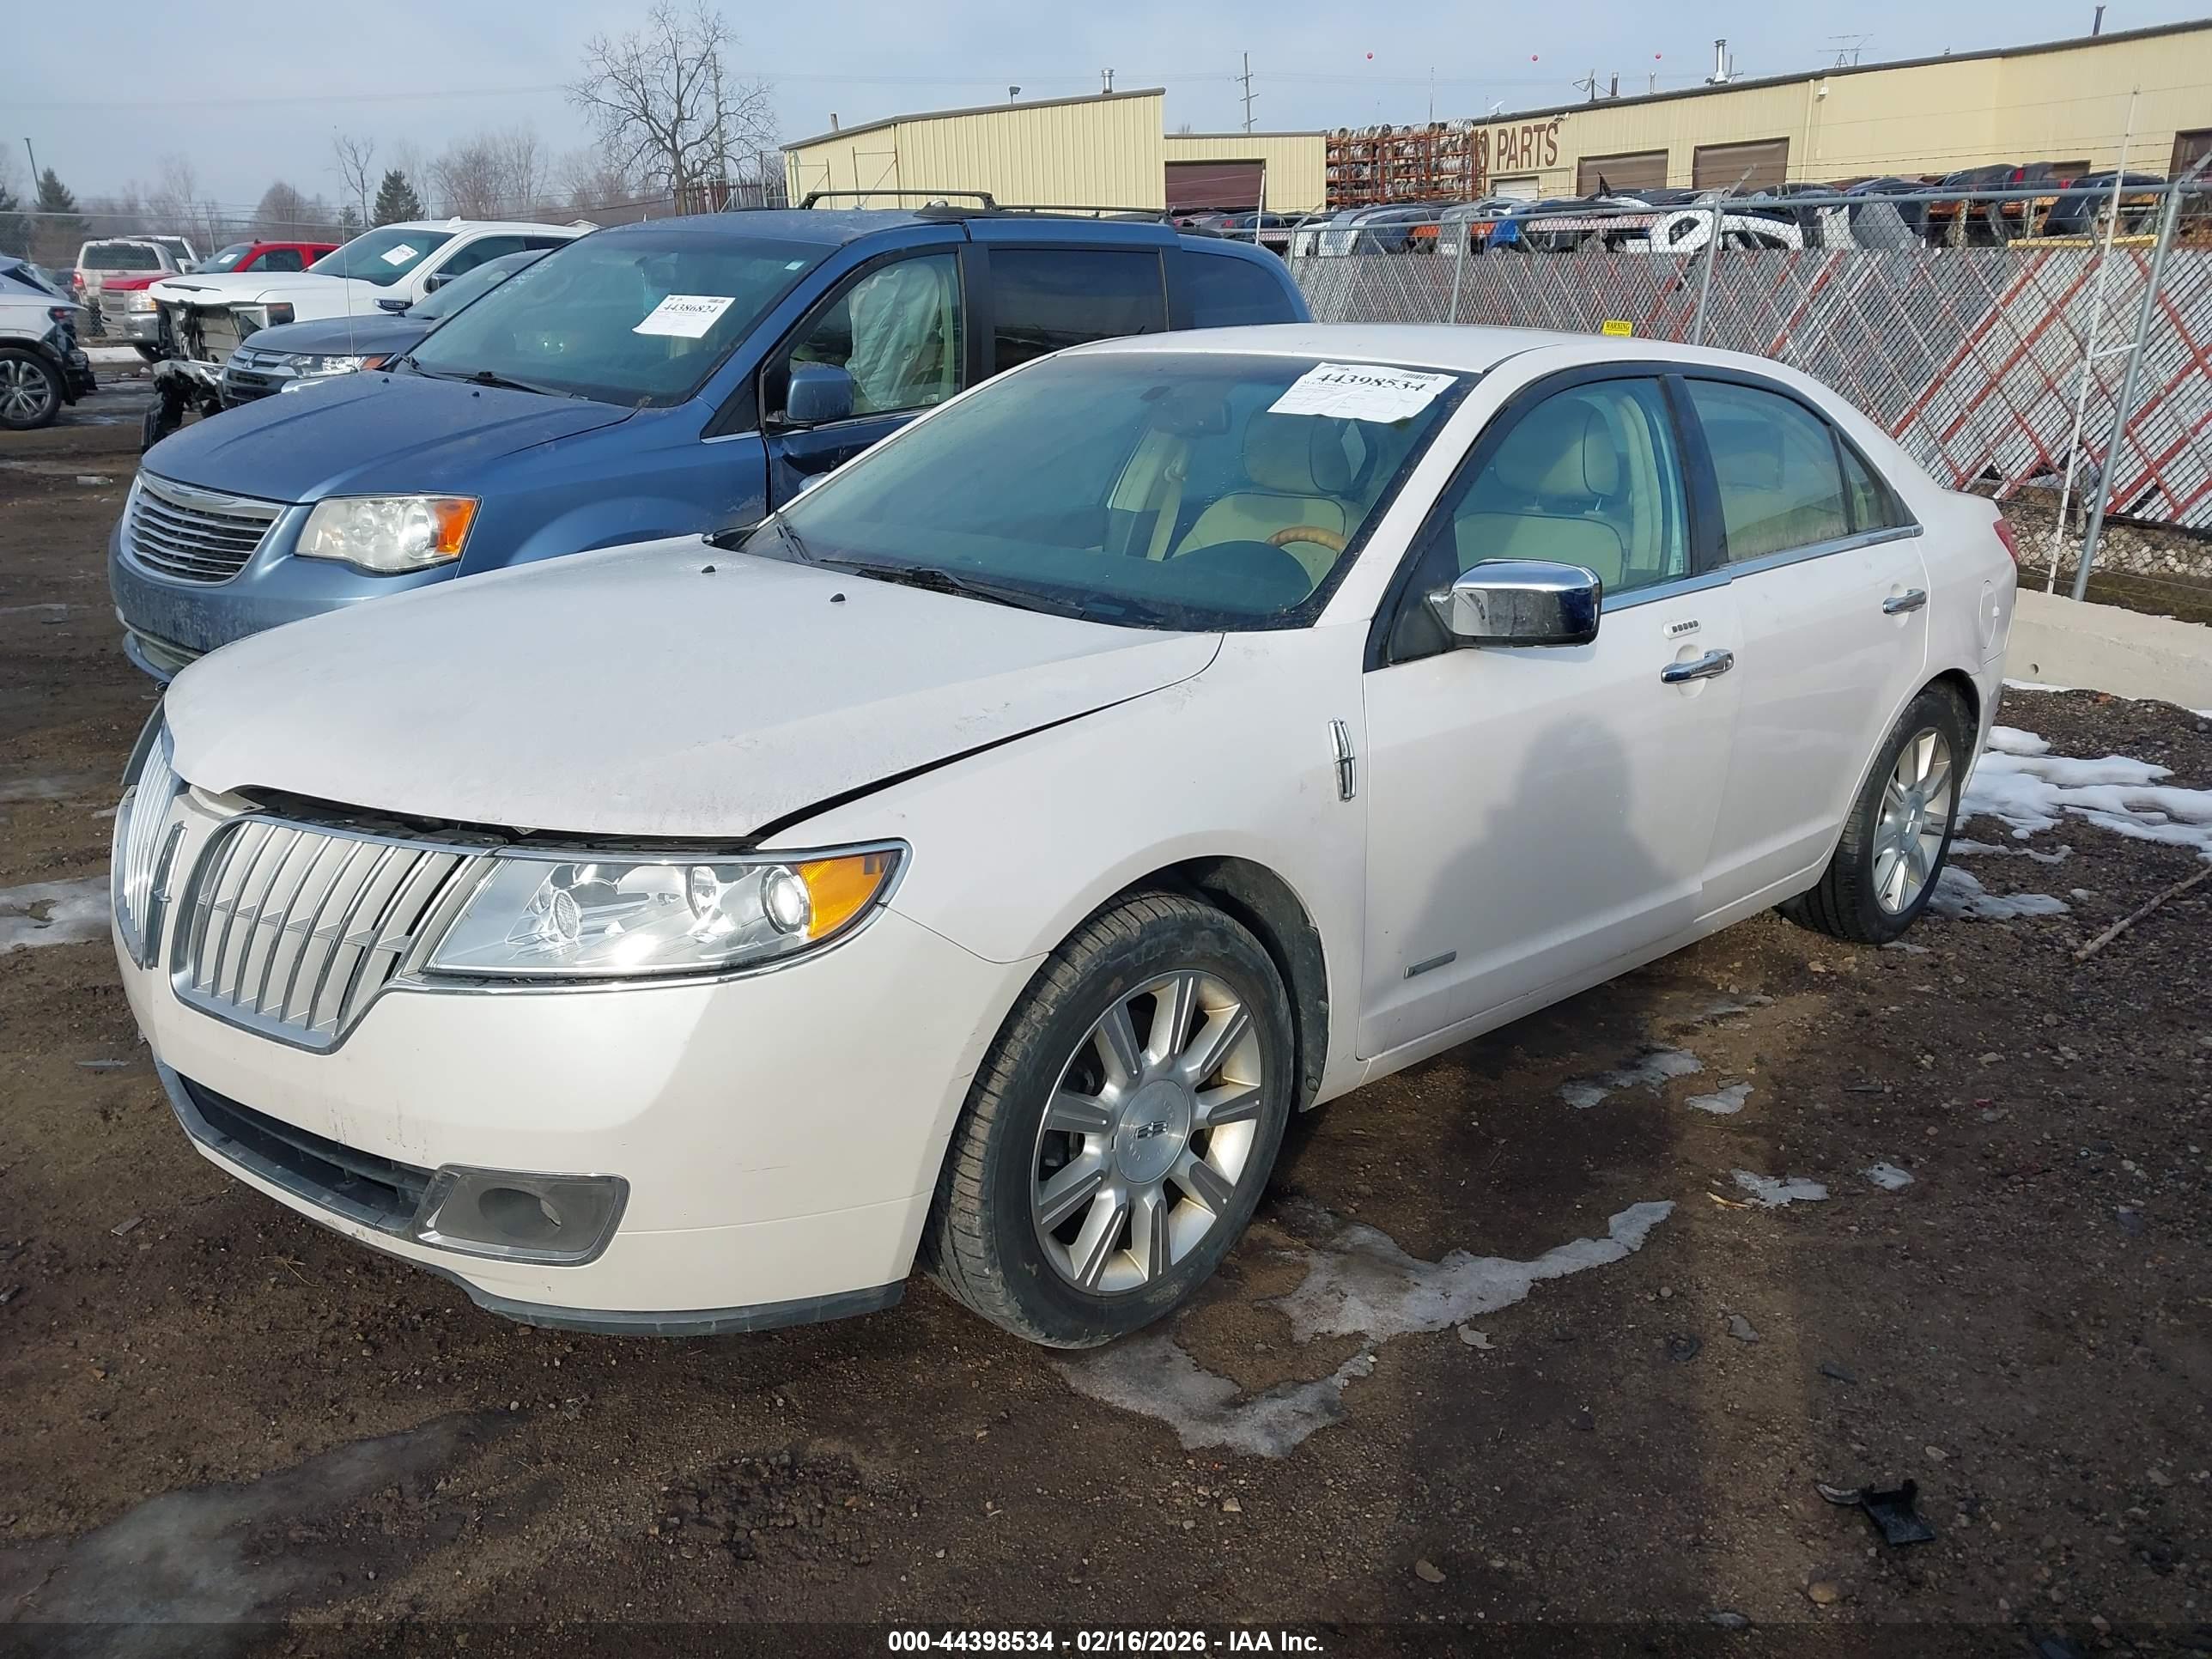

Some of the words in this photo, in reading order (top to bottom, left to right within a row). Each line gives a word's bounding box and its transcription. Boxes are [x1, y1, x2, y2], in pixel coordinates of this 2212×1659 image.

[1497, 122, 1559, 171] PARTS
[664, 303, 719, 314] 44386824
[1316, 372, 1427, 392] 44398534
